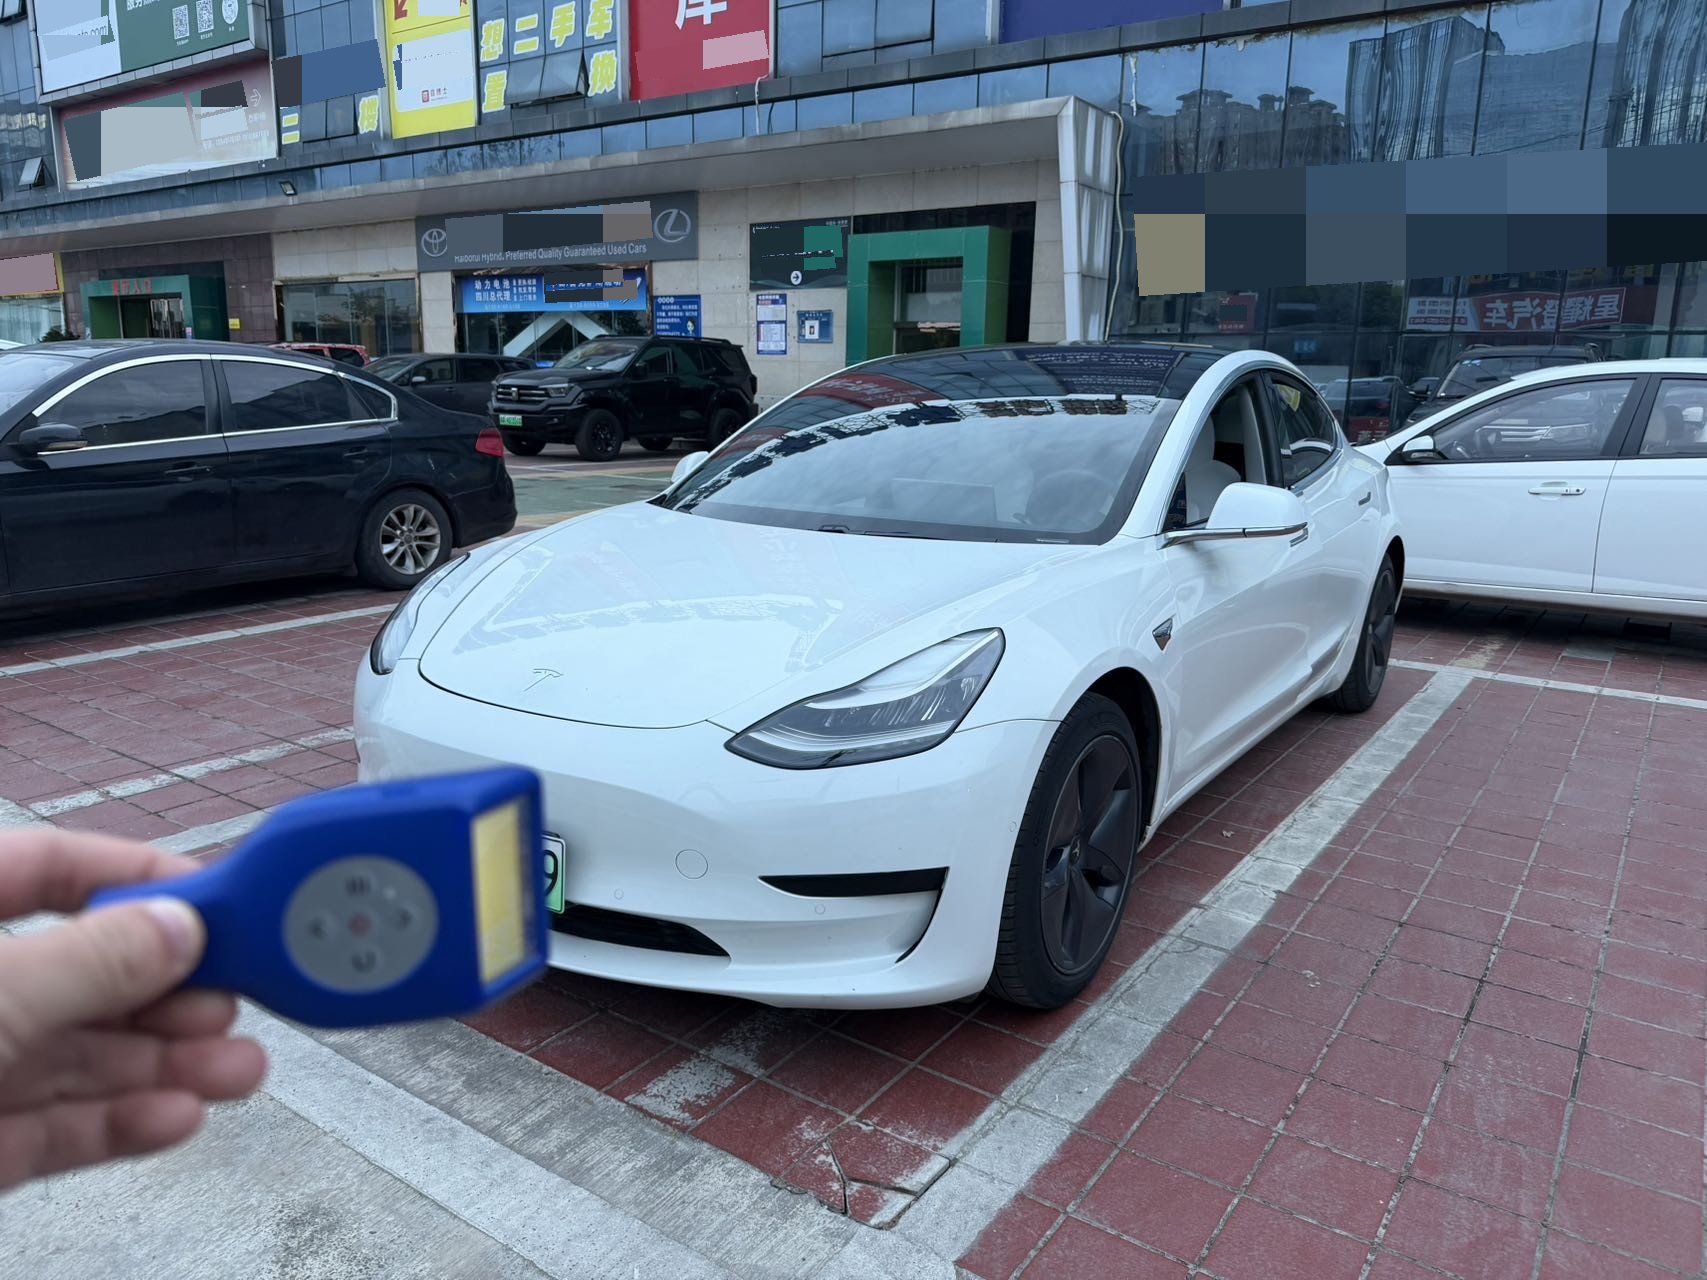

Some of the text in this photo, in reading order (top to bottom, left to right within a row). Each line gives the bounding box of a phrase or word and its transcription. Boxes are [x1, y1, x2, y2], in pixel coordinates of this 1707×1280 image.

[505, 250, 536, 261] Preferred
[537, 248, 562, 260] Quality
[563, 244, 606, 257] Guaranteed
[607, 243, 627, 255] Used
[628, 242, 647, 254] Cars
